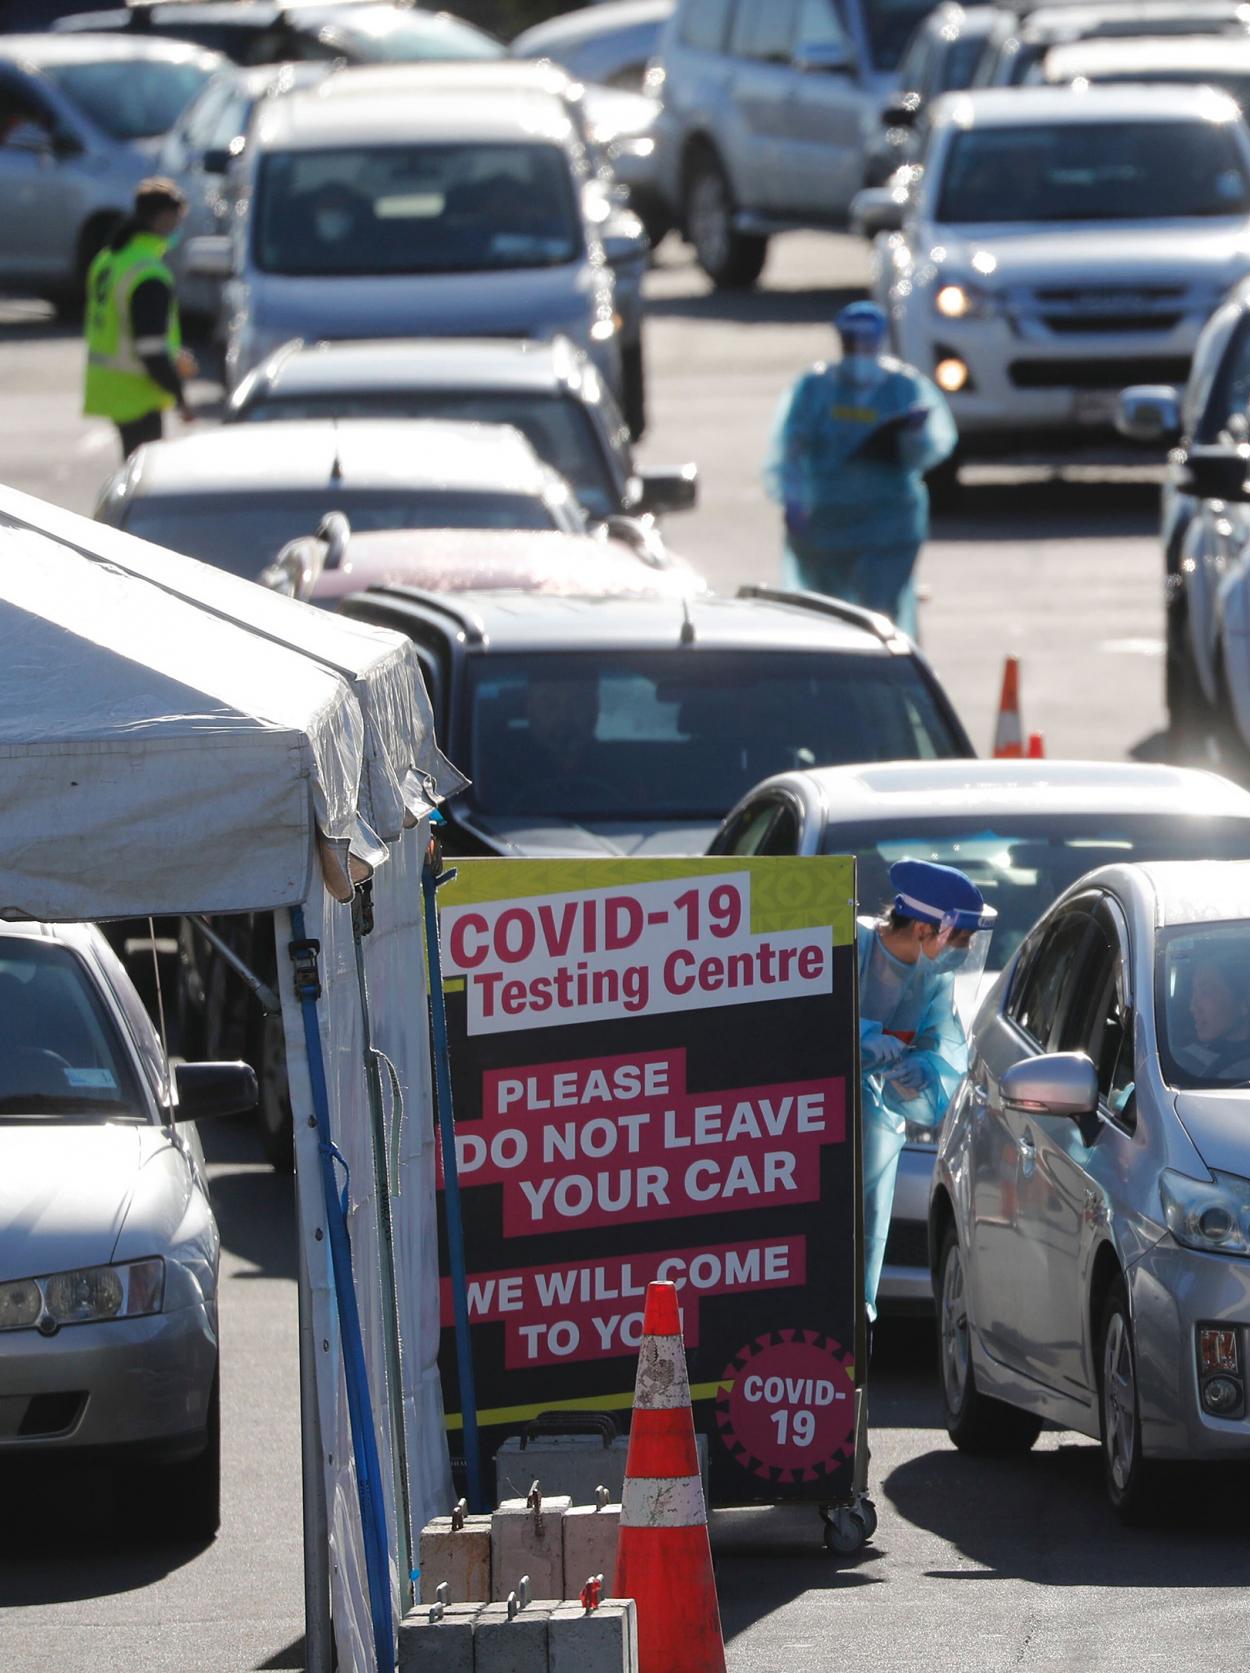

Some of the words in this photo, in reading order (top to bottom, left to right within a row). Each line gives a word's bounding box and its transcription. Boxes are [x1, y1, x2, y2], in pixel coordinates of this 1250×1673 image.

[450, 885, 741, 969] COVID-19
[474, 962, 649, 1017] Testing
[663, 943, 824, 995] Centre
[498, 1062, 670, 1114] PLEASE
[455, 1129, 528, 1173] DO
[544, 1114, 650, 1163] NOT
[664, 1093, 826, 1149] LEAVE
[519, 1166, 670, 1220] YOUR
[684, 1151, 797, 1201] CAR
[467, 1277, 523, 1316] WE
[535, 1263, 645, 1308] WILL
[657, 1245, 790, 1291] COME
[519, 1321, 580, 1359] TO
[591, 1308, 684, 1350] YO
[744, 1375, 846, 1406] COVID-
[770, 1410, 815, 1447] 19
